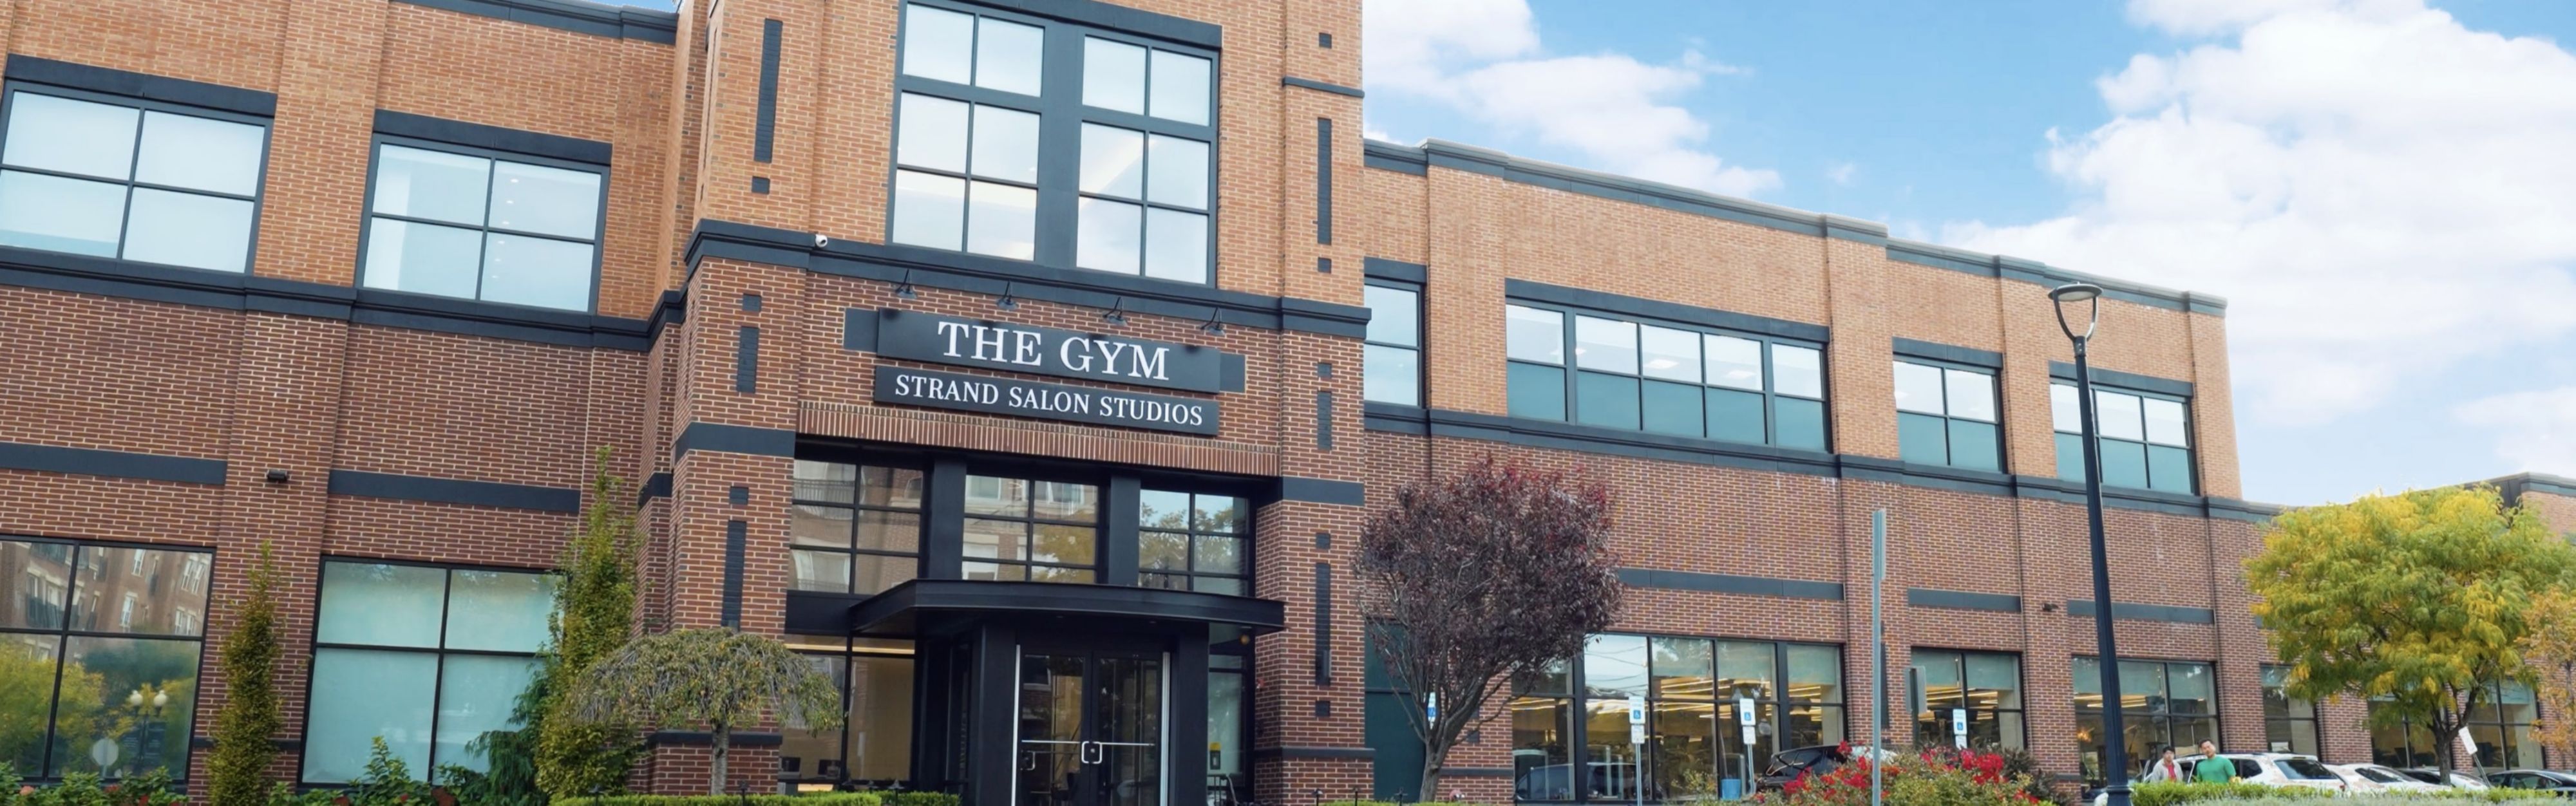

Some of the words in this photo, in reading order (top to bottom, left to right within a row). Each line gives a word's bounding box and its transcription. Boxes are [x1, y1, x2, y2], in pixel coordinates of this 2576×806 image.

[937, 321, 1042, 366] THE
[1060, 336, 1170, 381] GYM
[895, 374, 999, 404] STRAND
[1009, 386, 1090, 415] SALON
[1099, 396, 1202, 426] STUDIOS
